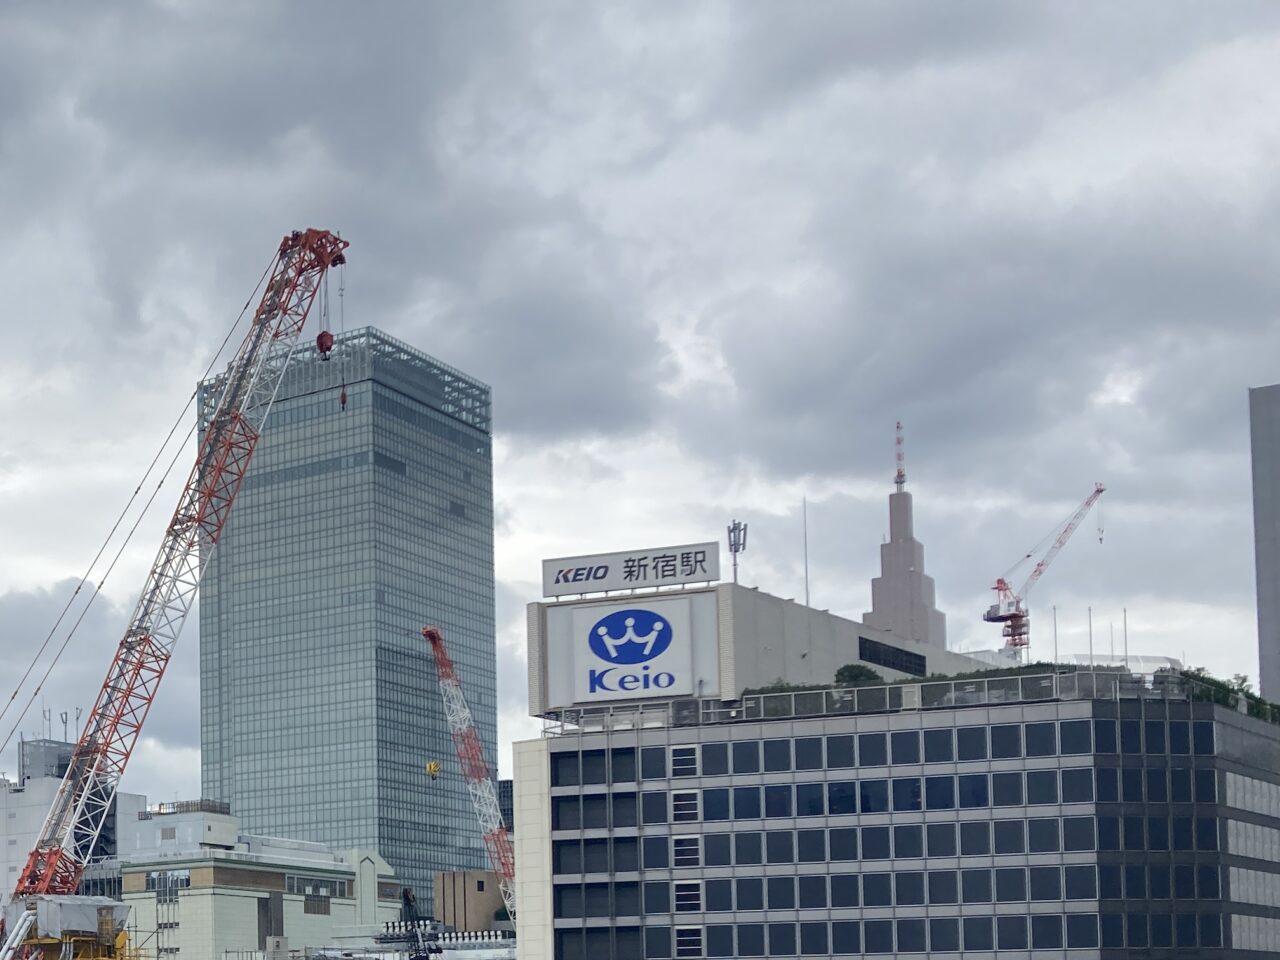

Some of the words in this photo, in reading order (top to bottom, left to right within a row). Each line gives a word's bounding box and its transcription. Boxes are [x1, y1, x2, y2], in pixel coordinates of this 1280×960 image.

[554, 565, 609, 585] KEIO
[623, 550, 708, 582] 新宿駅
[588, 665, 676, 694] Keio
